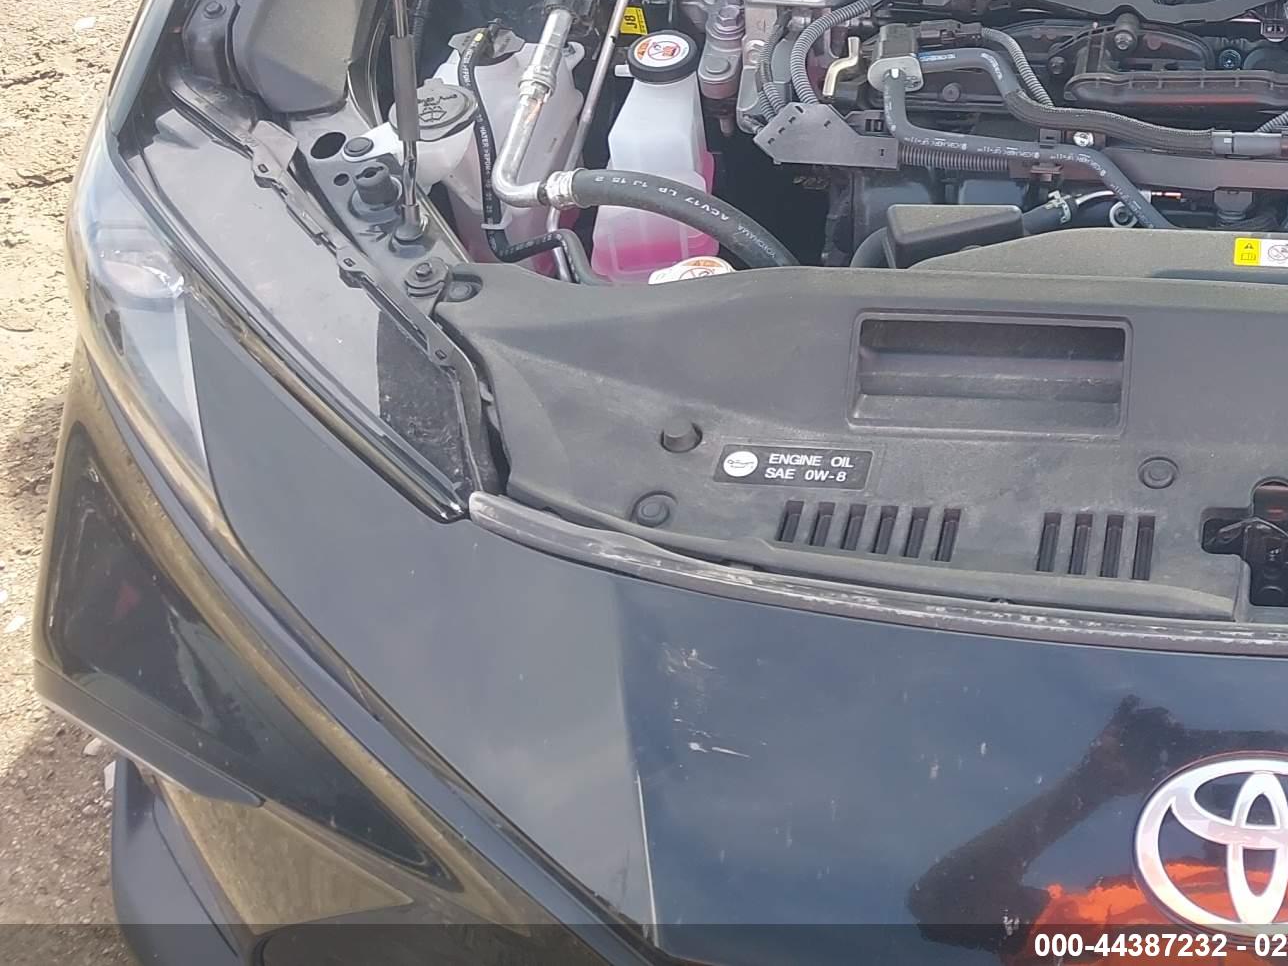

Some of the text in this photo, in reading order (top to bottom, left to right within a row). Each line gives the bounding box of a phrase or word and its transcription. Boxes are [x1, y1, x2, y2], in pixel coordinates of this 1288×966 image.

[658, 186, 678, 197] LP
[684, 196, 730, 222] ACV17
[768, 453, 855, 468] ENGINE OIL
[764, 467, 847, 482] SAE 0W-8
